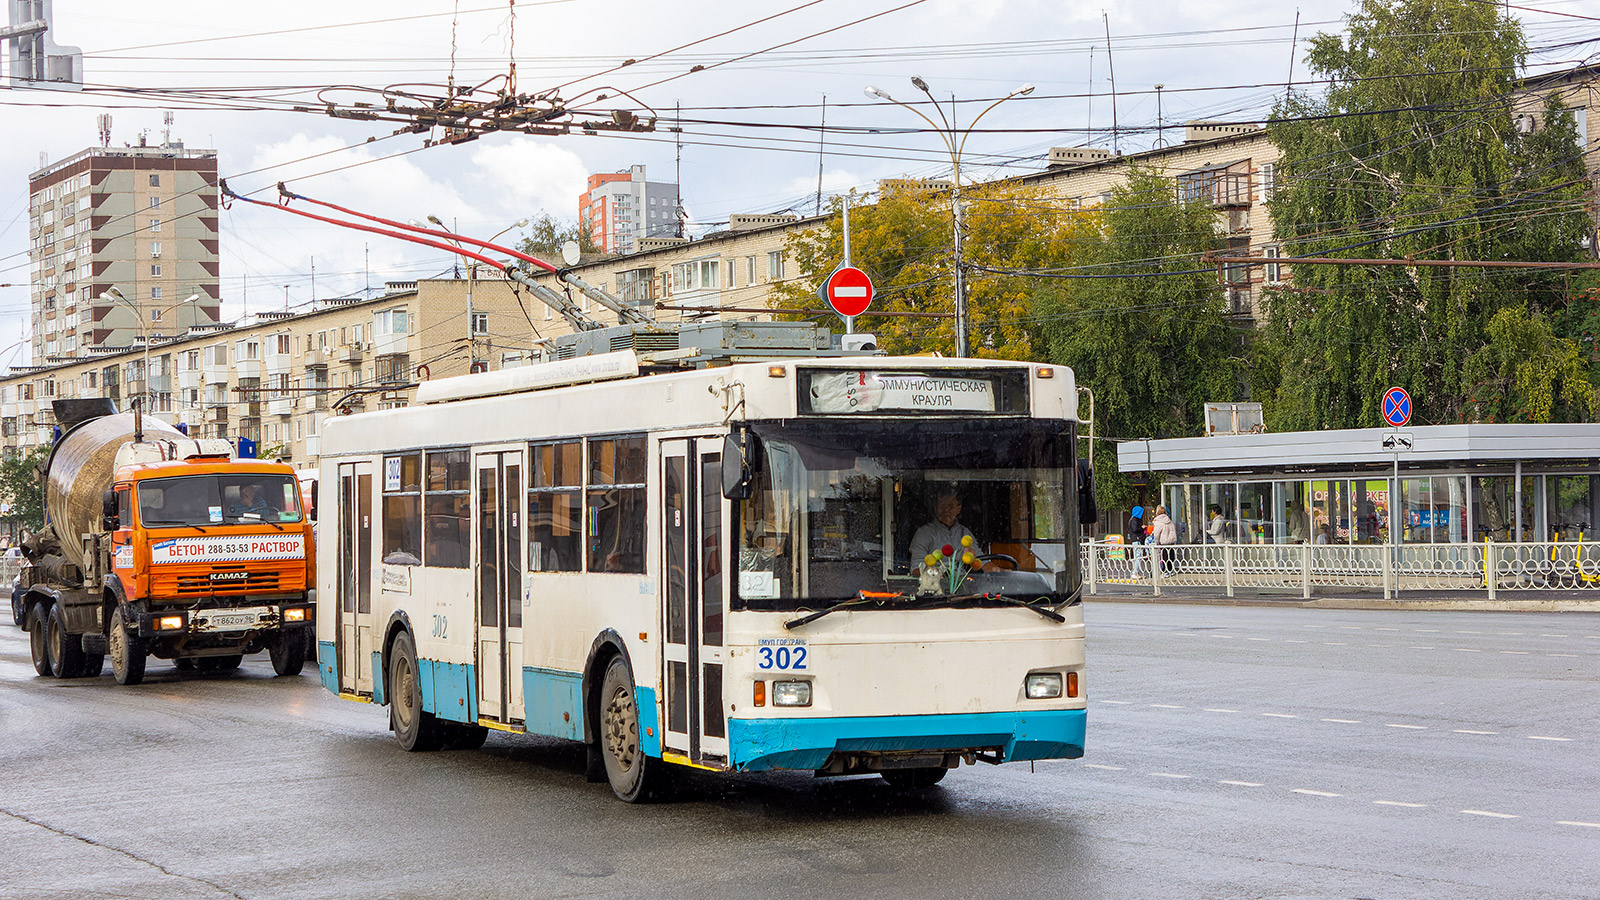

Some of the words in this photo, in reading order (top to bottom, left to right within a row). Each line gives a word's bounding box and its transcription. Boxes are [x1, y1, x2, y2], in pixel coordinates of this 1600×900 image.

[911, 394, 953, 406] КРАУЛЯ
[389, 459, 400, 480] 302
[169, 544, 205, 557] БЕТОН
[208, 543, 249, 554] 288-53-53
[251, 541, 300, 554] РАСТВОР
[209, 572, 249, 581] KAMAZ
[432, 614, 448, 639] 302
[758, 647, 807, 669] 302
